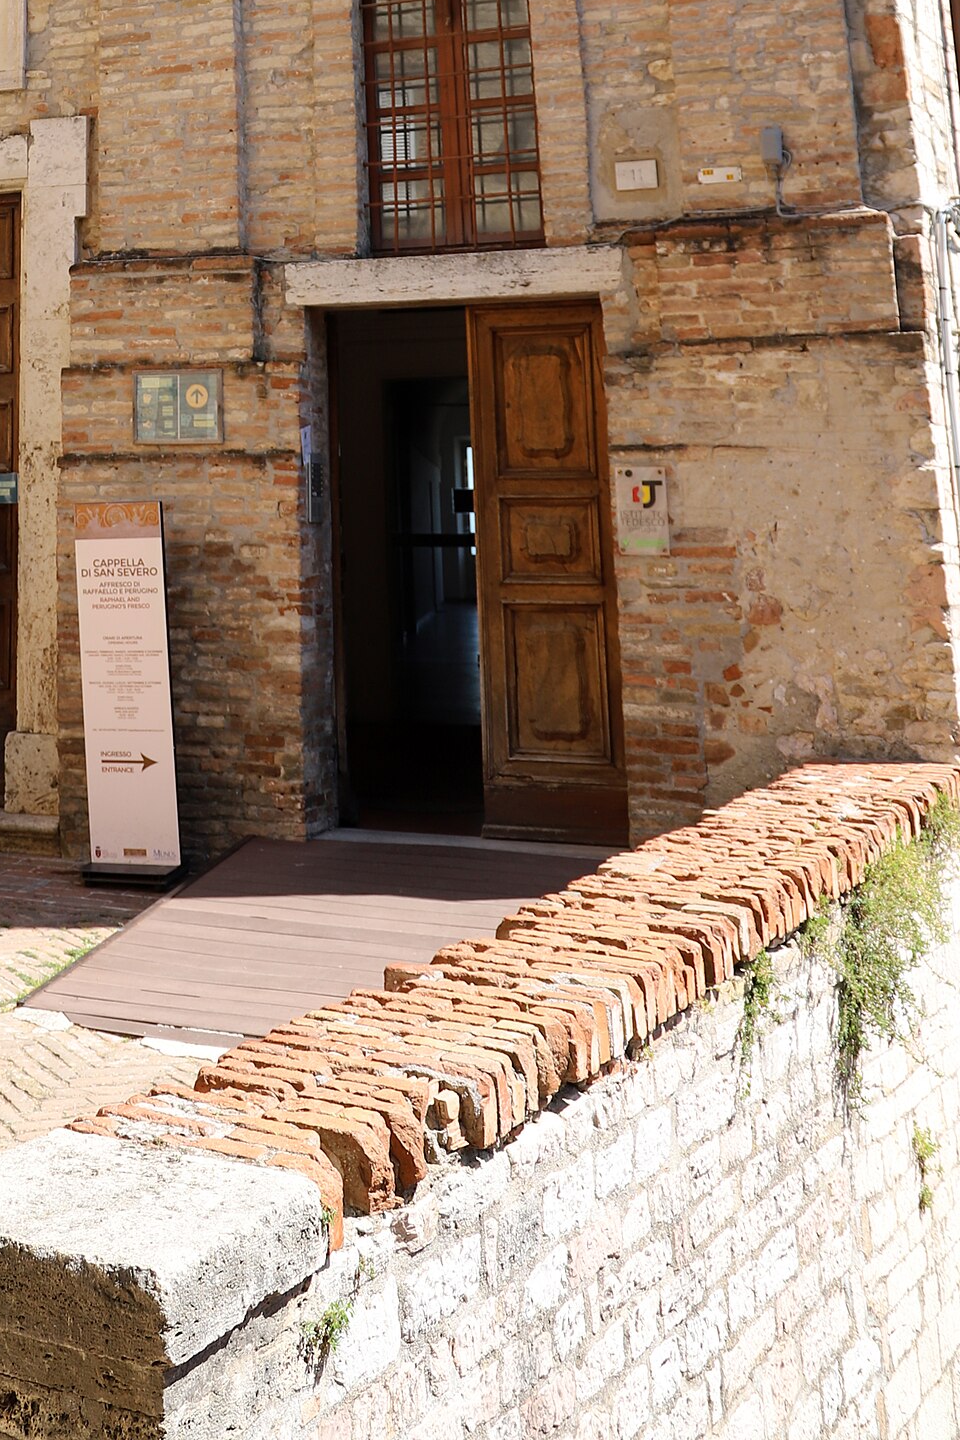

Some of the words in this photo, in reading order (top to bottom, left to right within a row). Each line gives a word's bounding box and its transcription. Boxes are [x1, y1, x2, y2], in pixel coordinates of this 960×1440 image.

[93, 558, 145, 567] CAPPELLA
[81, 569, 91, 577] DI
[94, 568, 114, 577] SAN
[117, 567, 158, 576] SEVERO
